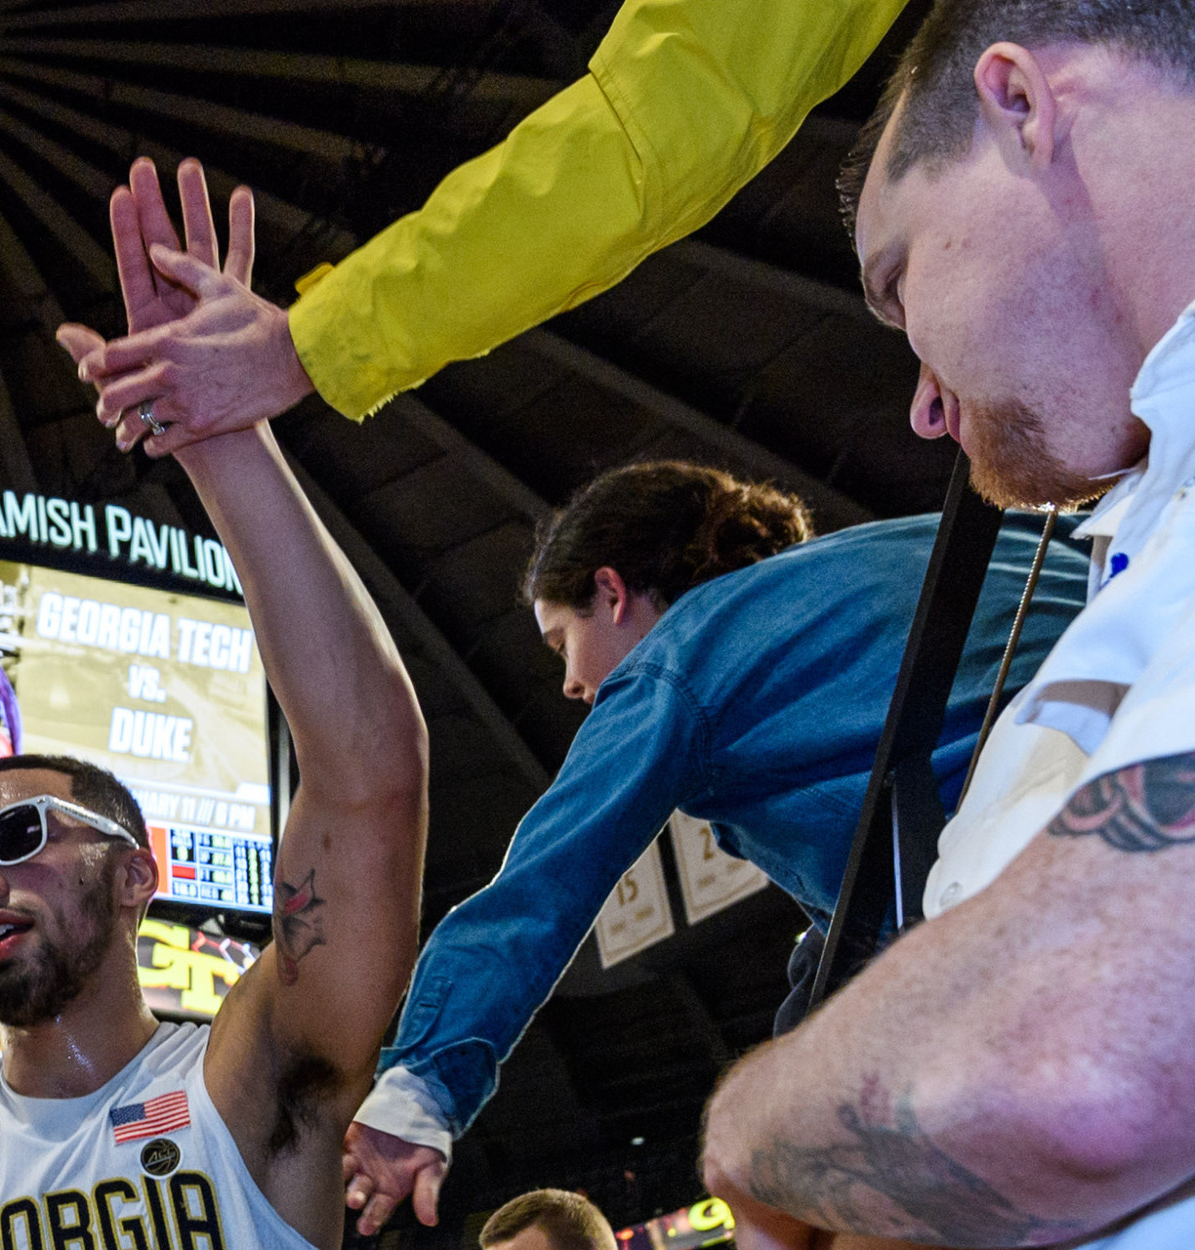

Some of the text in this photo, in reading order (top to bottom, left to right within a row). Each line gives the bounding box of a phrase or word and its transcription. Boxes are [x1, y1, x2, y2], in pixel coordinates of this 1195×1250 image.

[35, 591, 253, 675] GEORGIA TECH
[127, 663, 167, 704] VS.
[107, 705, 194, 763] DUKE
[615, 869, 638, 907] 15
